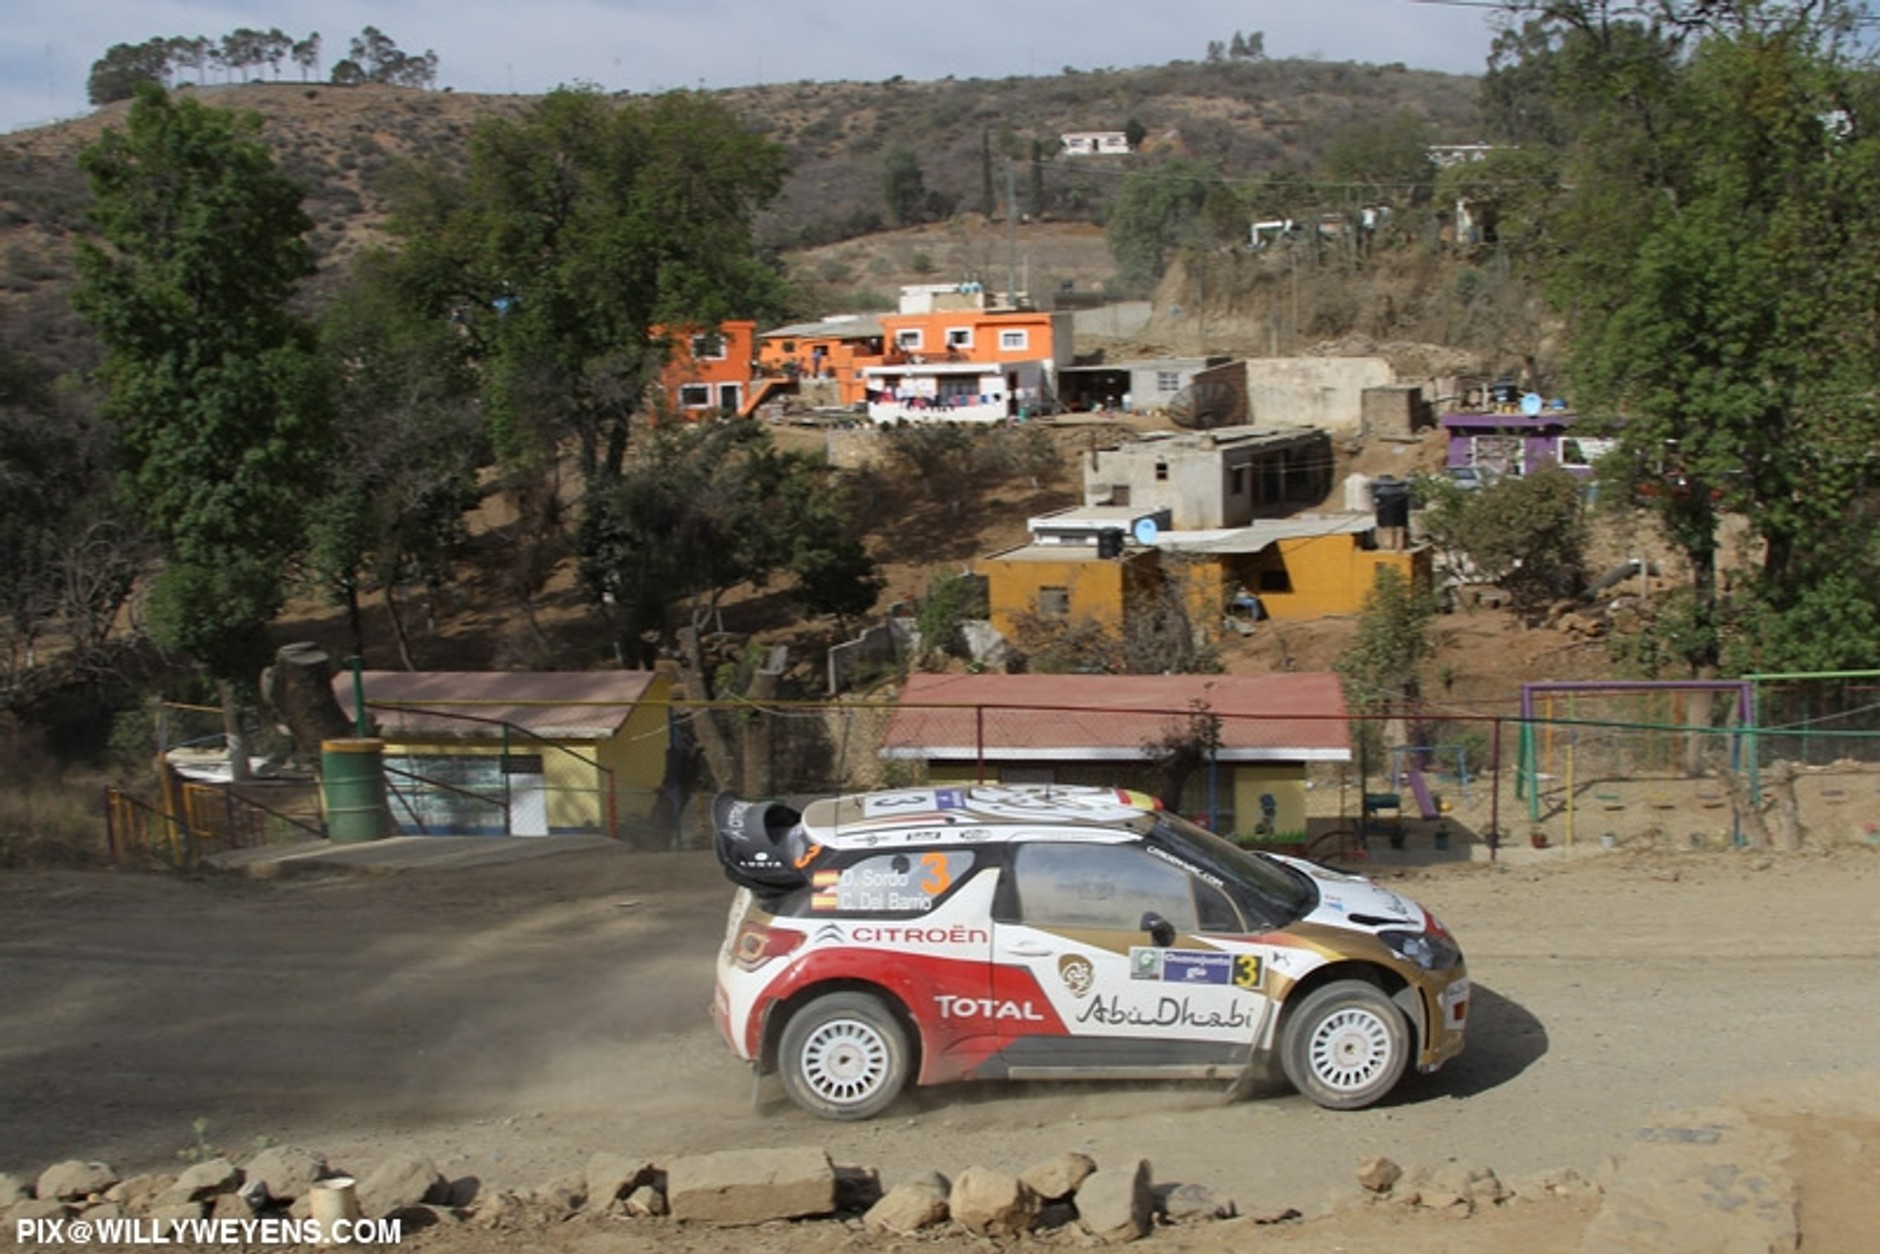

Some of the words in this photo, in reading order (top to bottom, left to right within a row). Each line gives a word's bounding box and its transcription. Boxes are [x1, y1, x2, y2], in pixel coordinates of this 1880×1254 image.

[793, 843, 822, 871] 3
[861, 868, 908, 887] Sordo
[921, 852, 951, 895] 3
[1235, 954, 1259, 987] 3
[933, 995, 1045, 1021] TOTAL
